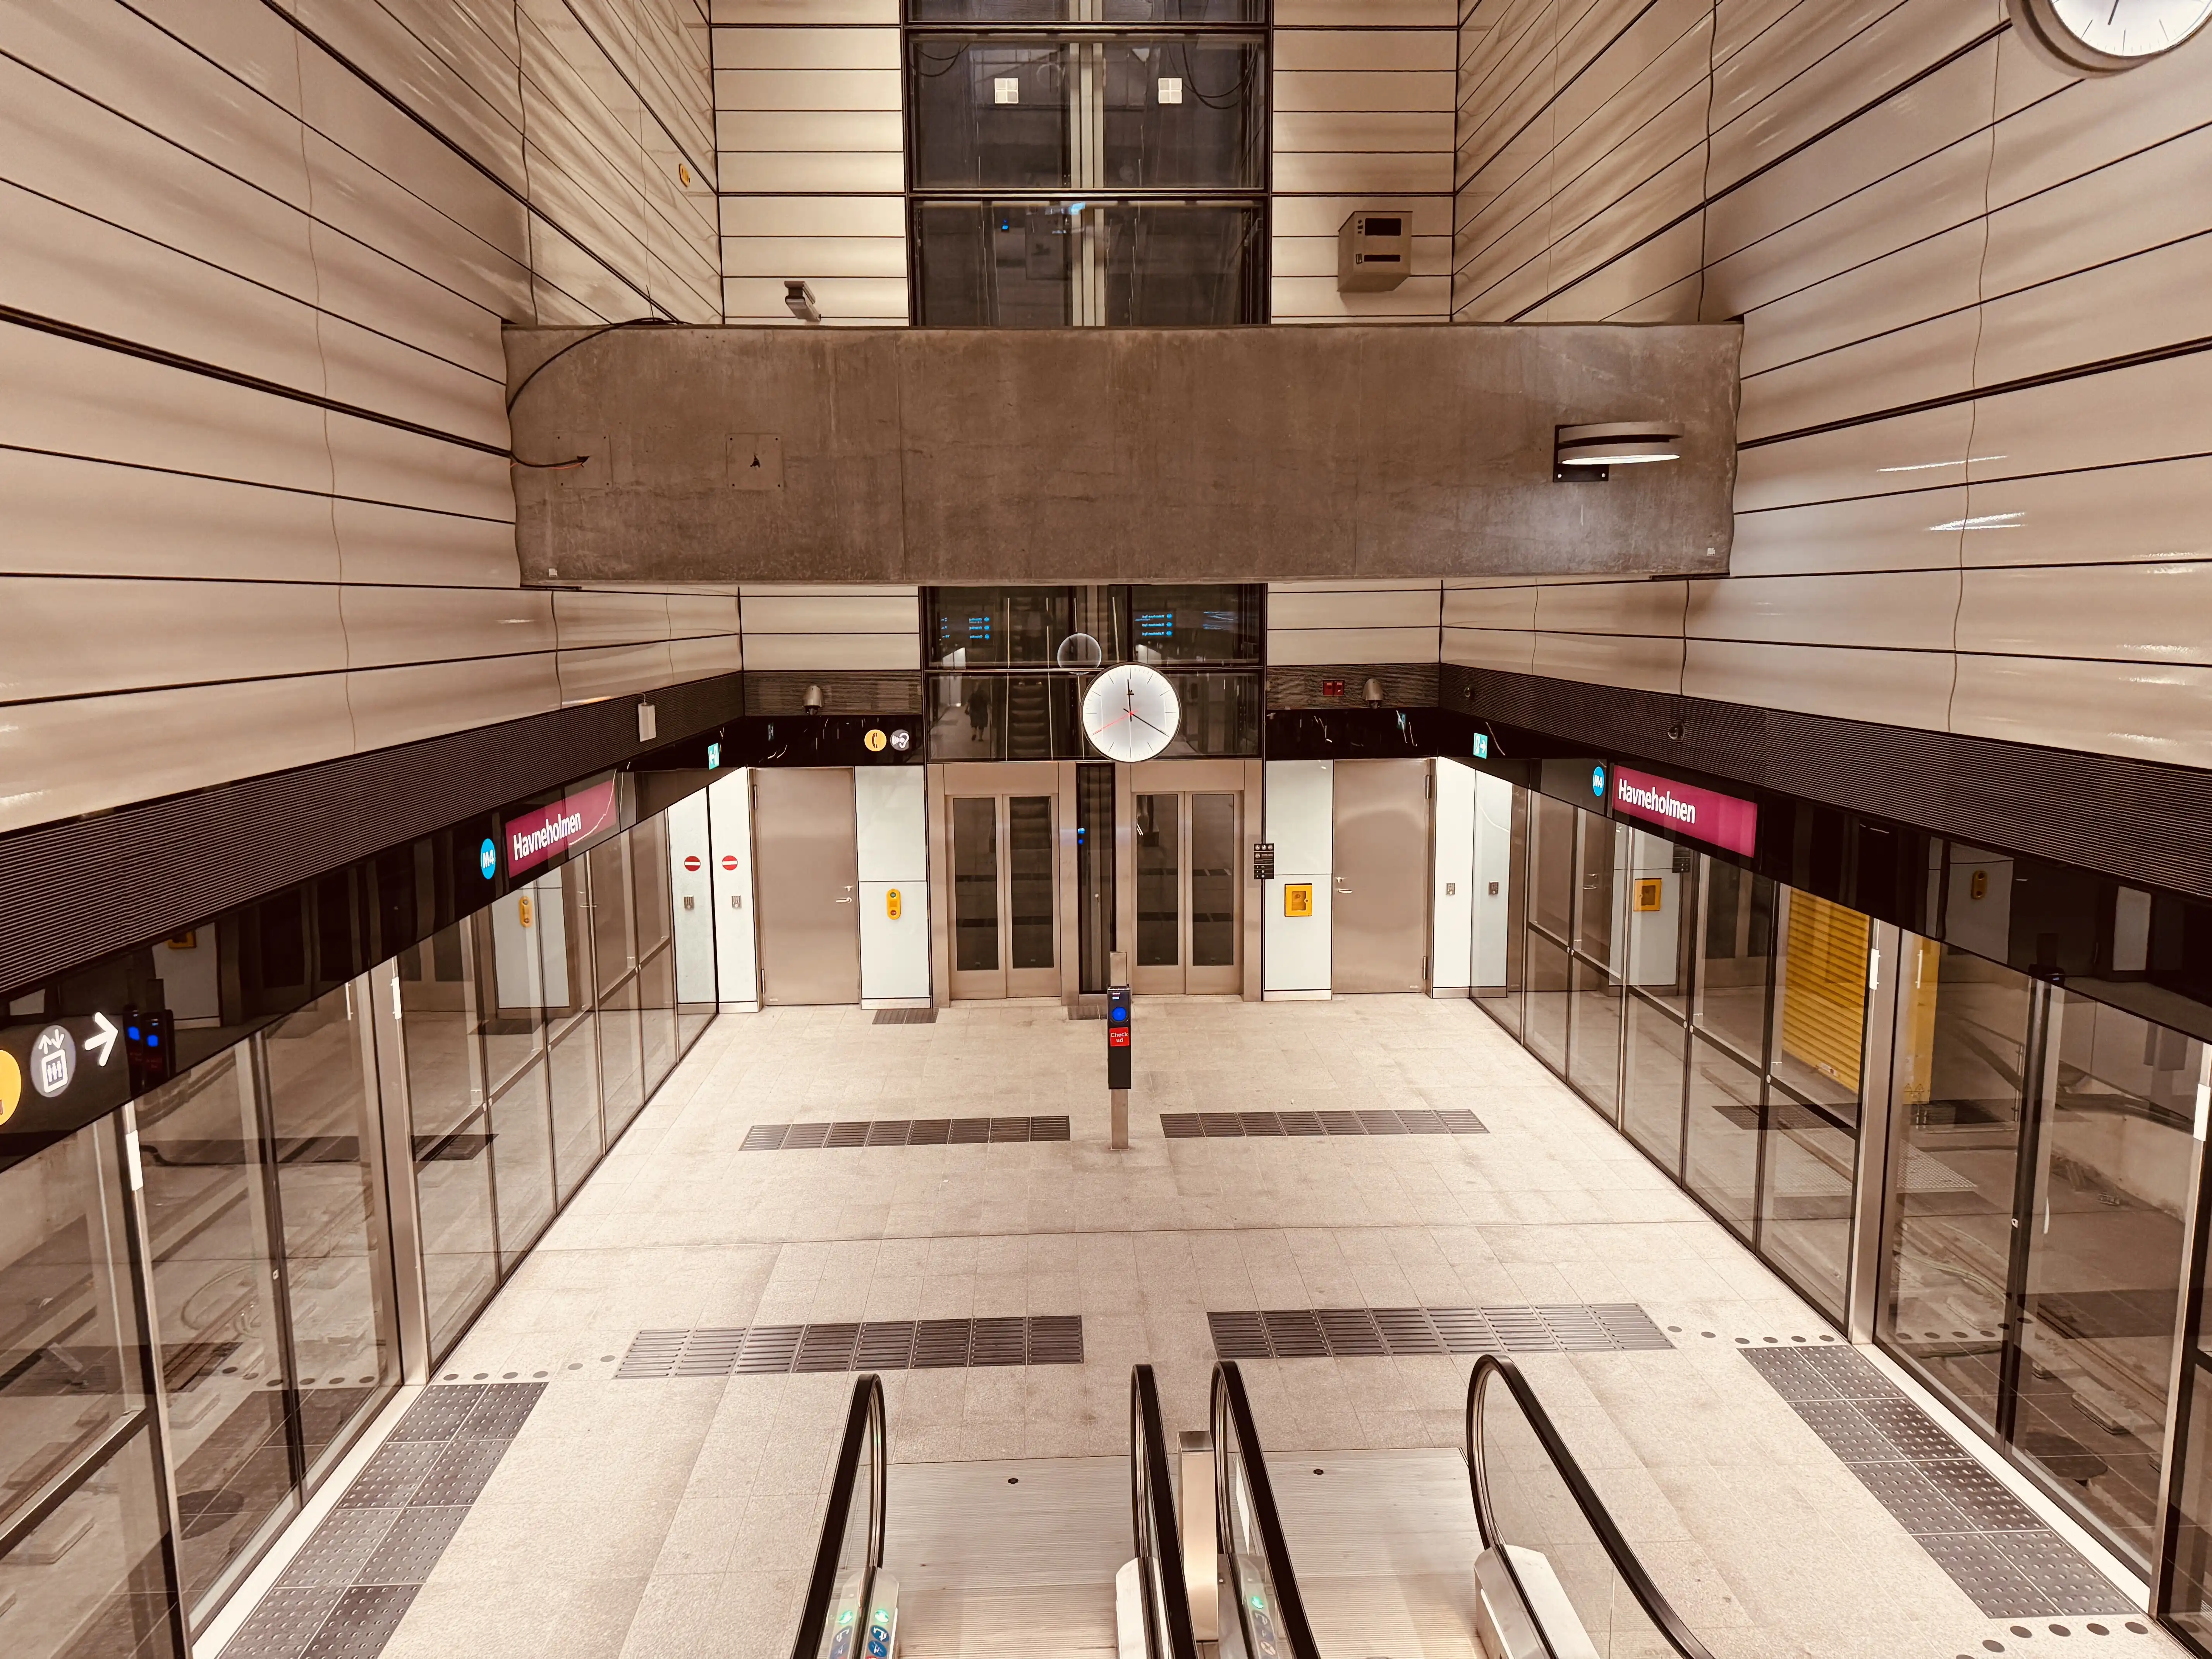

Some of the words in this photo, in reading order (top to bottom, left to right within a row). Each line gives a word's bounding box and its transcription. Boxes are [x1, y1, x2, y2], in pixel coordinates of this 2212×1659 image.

[1594, 775, 1602, 788] M4
[1619, 779, 1695, 824] Havneholmen
[514, 812, 580, 860] Havneholmen
[483, 850, 494, 868] M4
